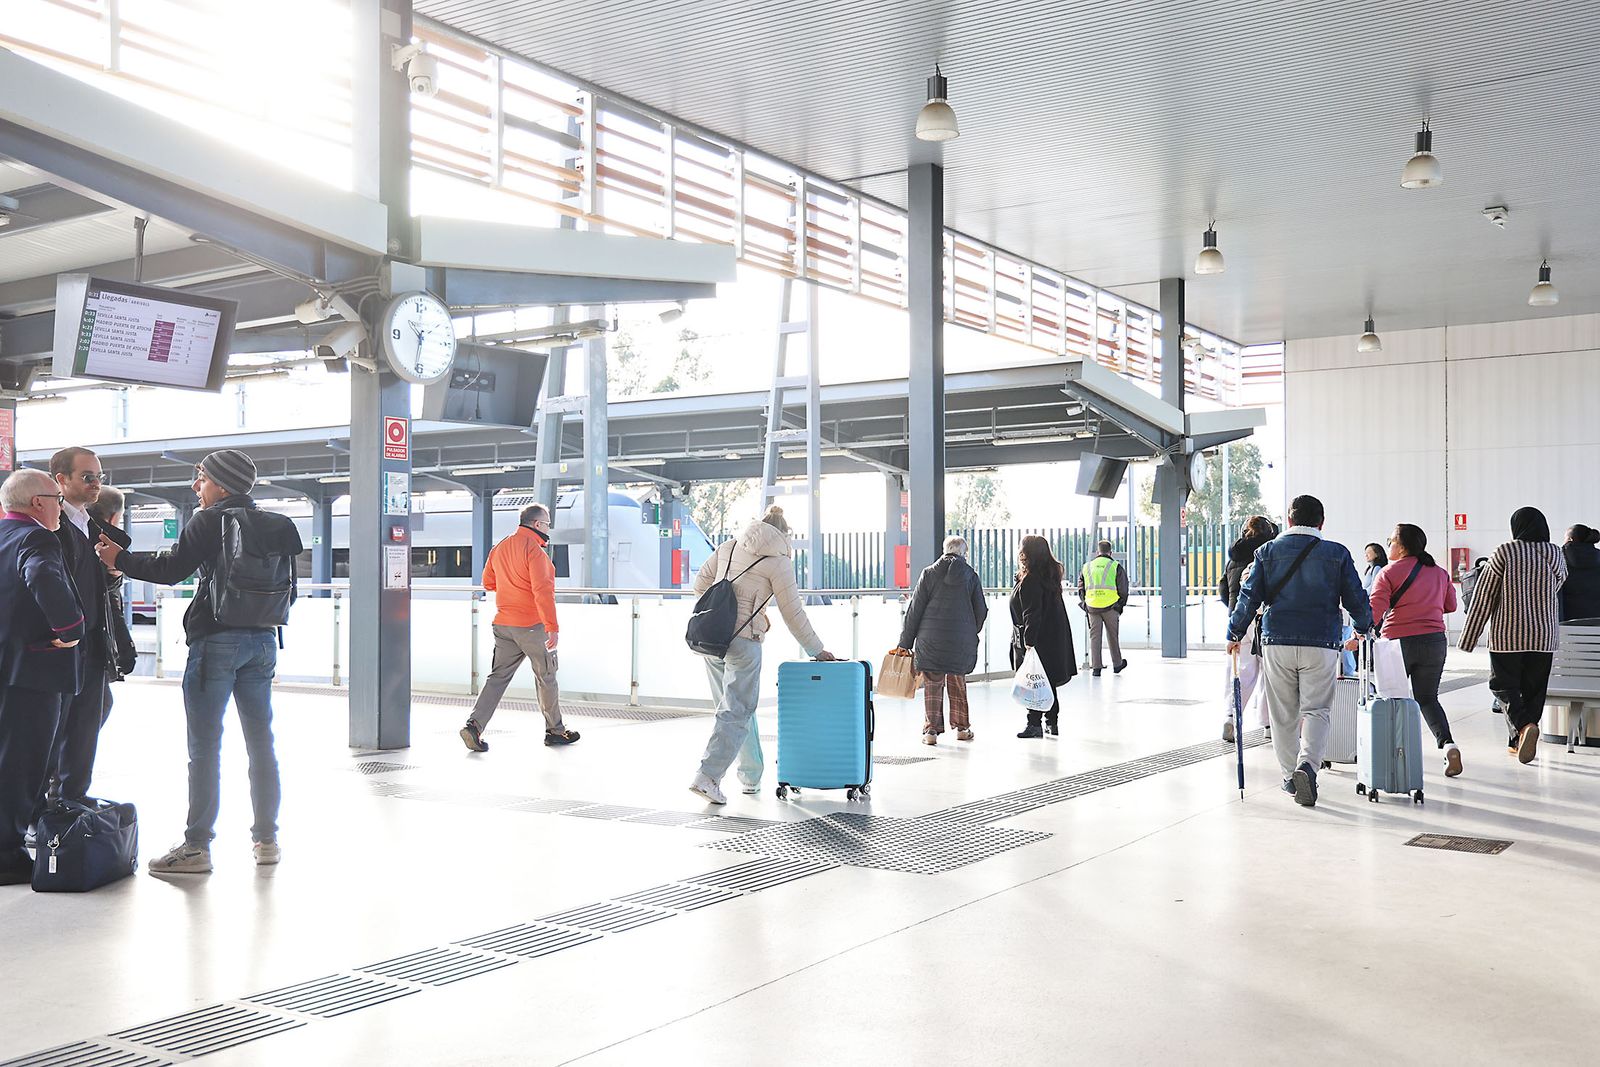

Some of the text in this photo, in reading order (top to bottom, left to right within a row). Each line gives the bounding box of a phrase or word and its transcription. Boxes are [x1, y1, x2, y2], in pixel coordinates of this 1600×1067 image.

[101, 293, 127, 302] Llegadas
[392, 328, 400, 340] 9
[414, 364, 424, 374] 6
[642, 512, 648, 523] 5
